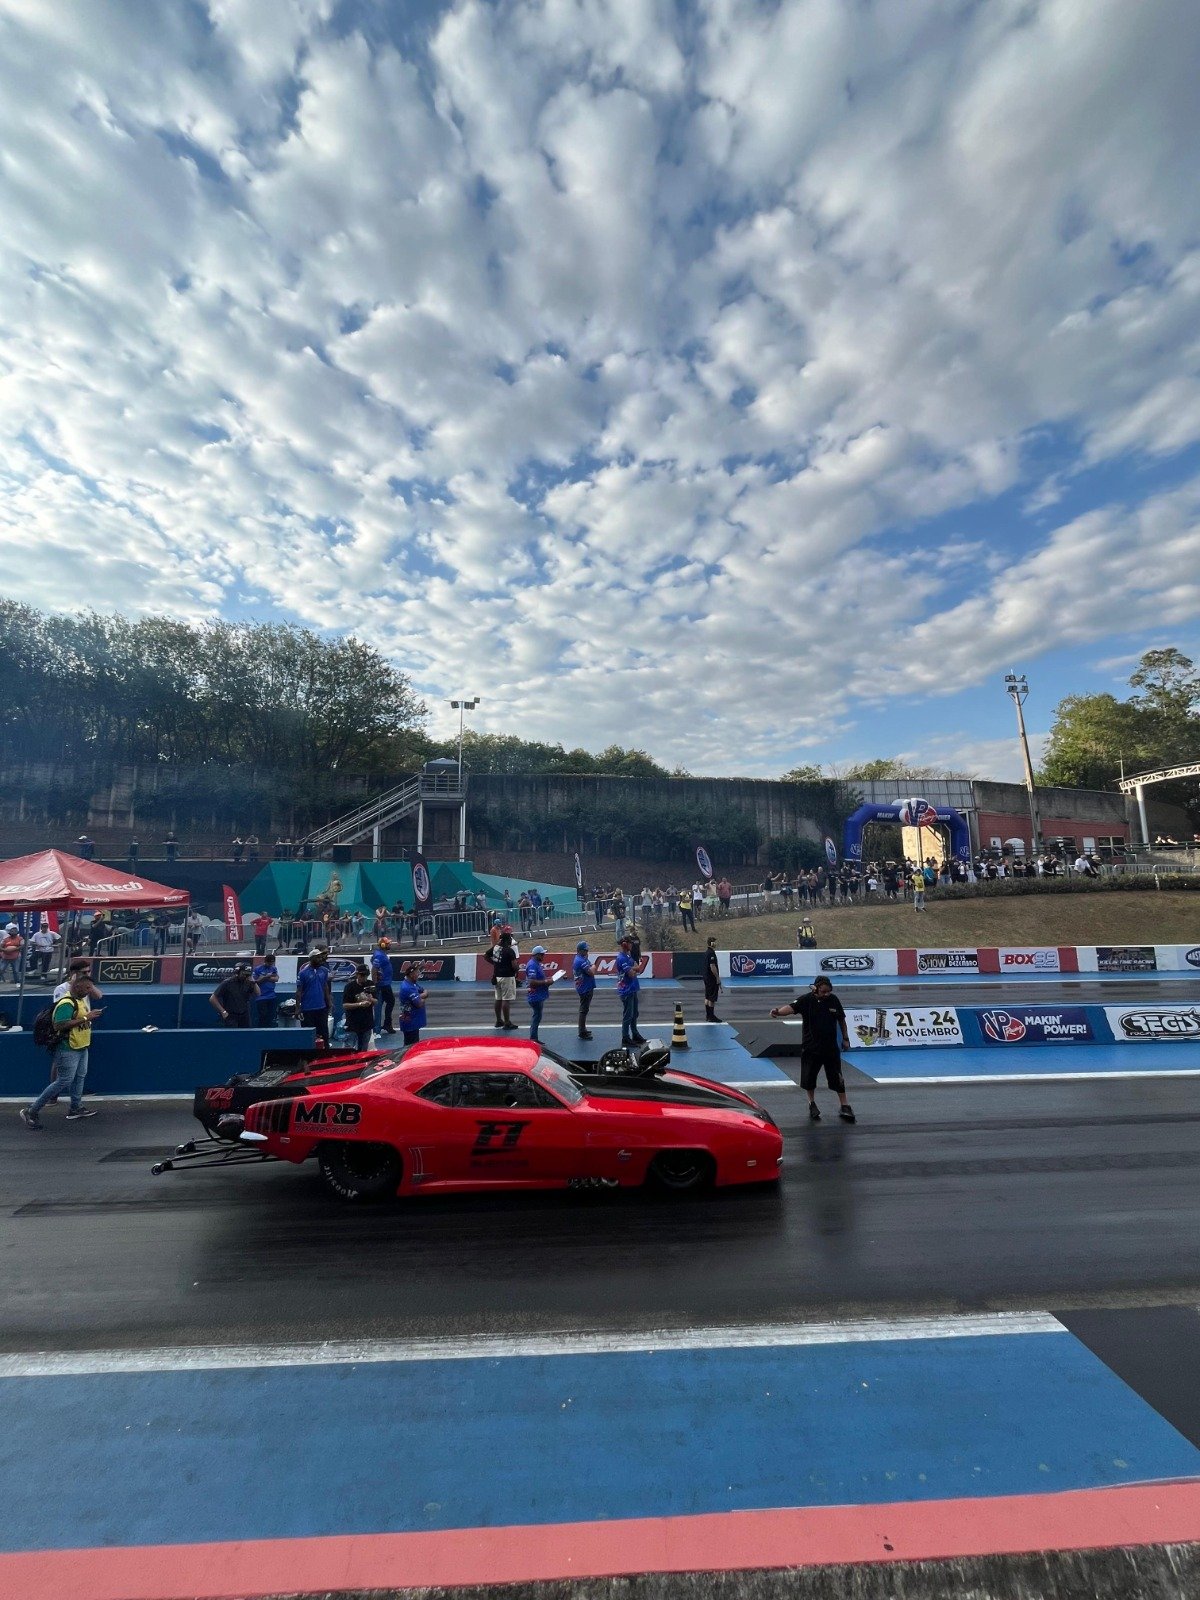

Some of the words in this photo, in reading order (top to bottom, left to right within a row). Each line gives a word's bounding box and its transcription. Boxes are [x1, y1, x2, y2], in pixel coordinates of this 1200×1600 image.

[893, 1011, 914, 1027] 21
[929, 1010, 956, 1026] 24
[1024, 1014, 1063, 1026] MAKIN'
[896, 1027, 960, 1037] NOVEMBRO
[1043, 1024, 1087, 1035] POWER!
[204, 1087, 234, 1100] 174
[294, 1102, 362, 1125] MRB
